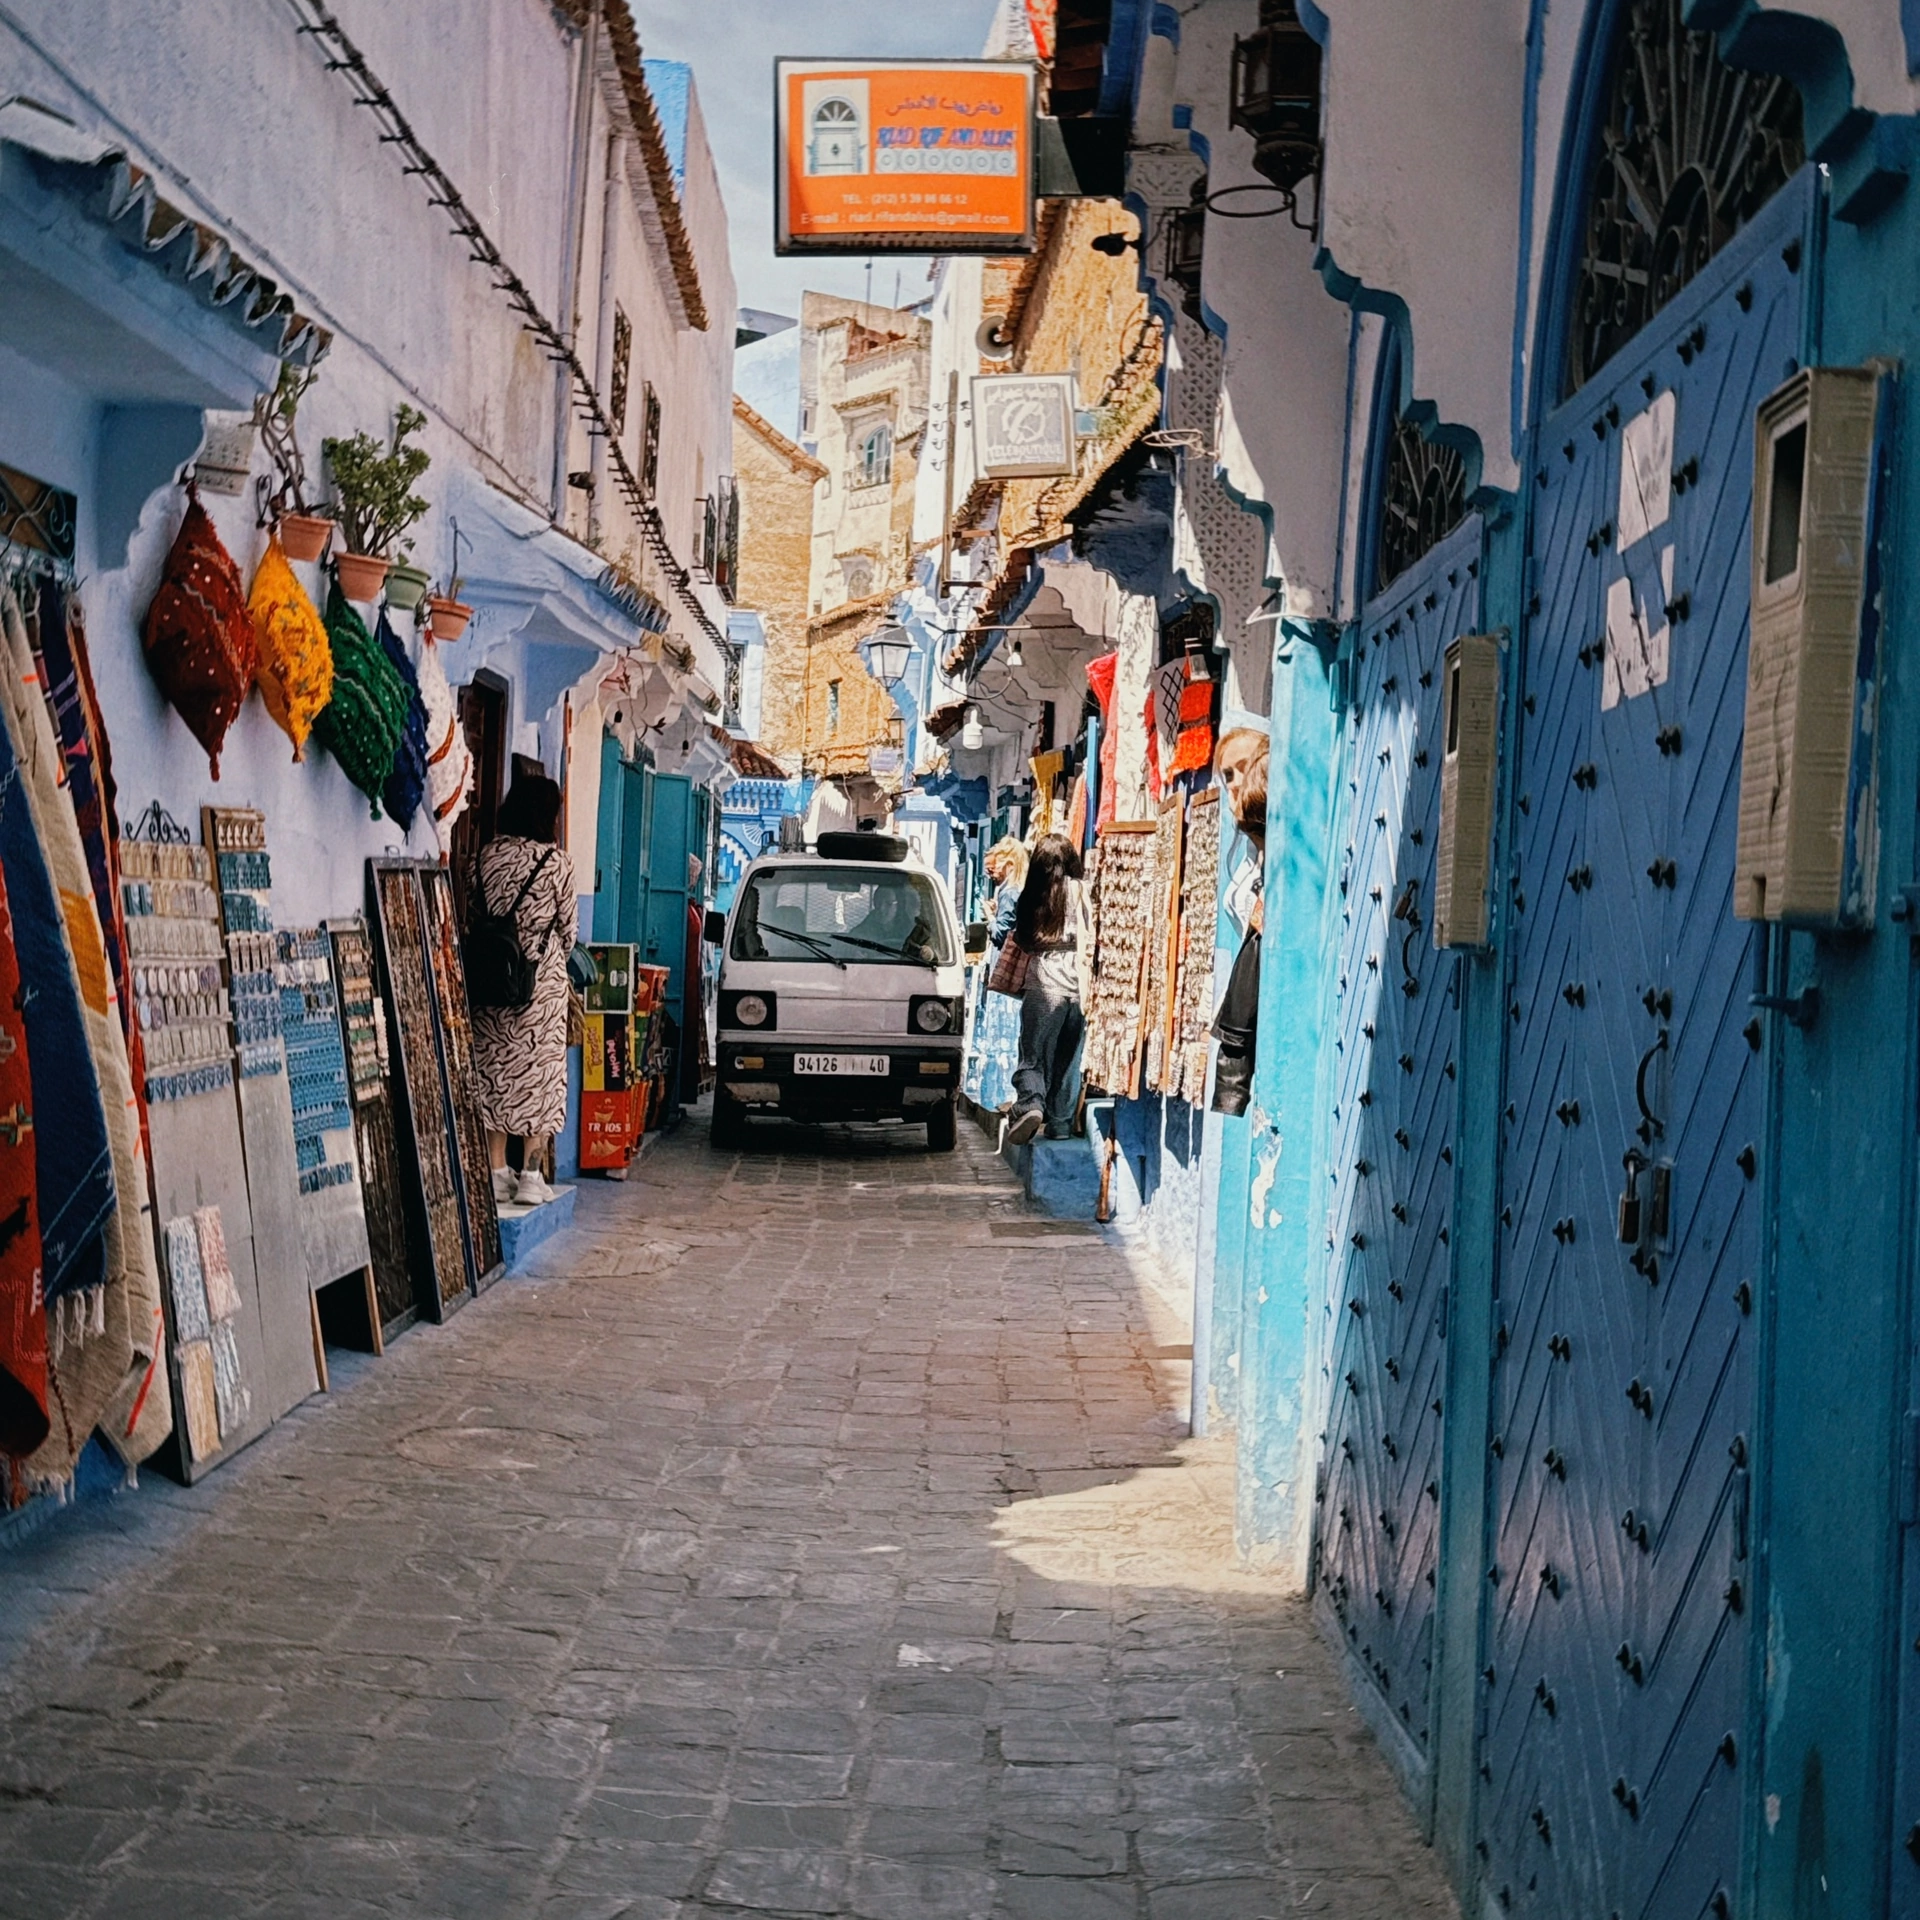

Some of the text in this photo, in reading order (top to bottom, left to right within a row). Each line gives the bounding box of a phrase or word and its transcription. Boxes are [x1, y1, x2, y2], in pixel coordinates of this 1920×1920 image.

[876, 126, 915, 145] RIAD
[919, 126, 946, 146] RIF
[841, 193, 862, 204] TEL
[871, 193, 898, 206] (212)
[955, 194, 968, 205] 12
[800, 212, 838, 224] E-mail
[798, 1056, 838, 1072] 94126
[869, 1058, 885, 1073] 40
